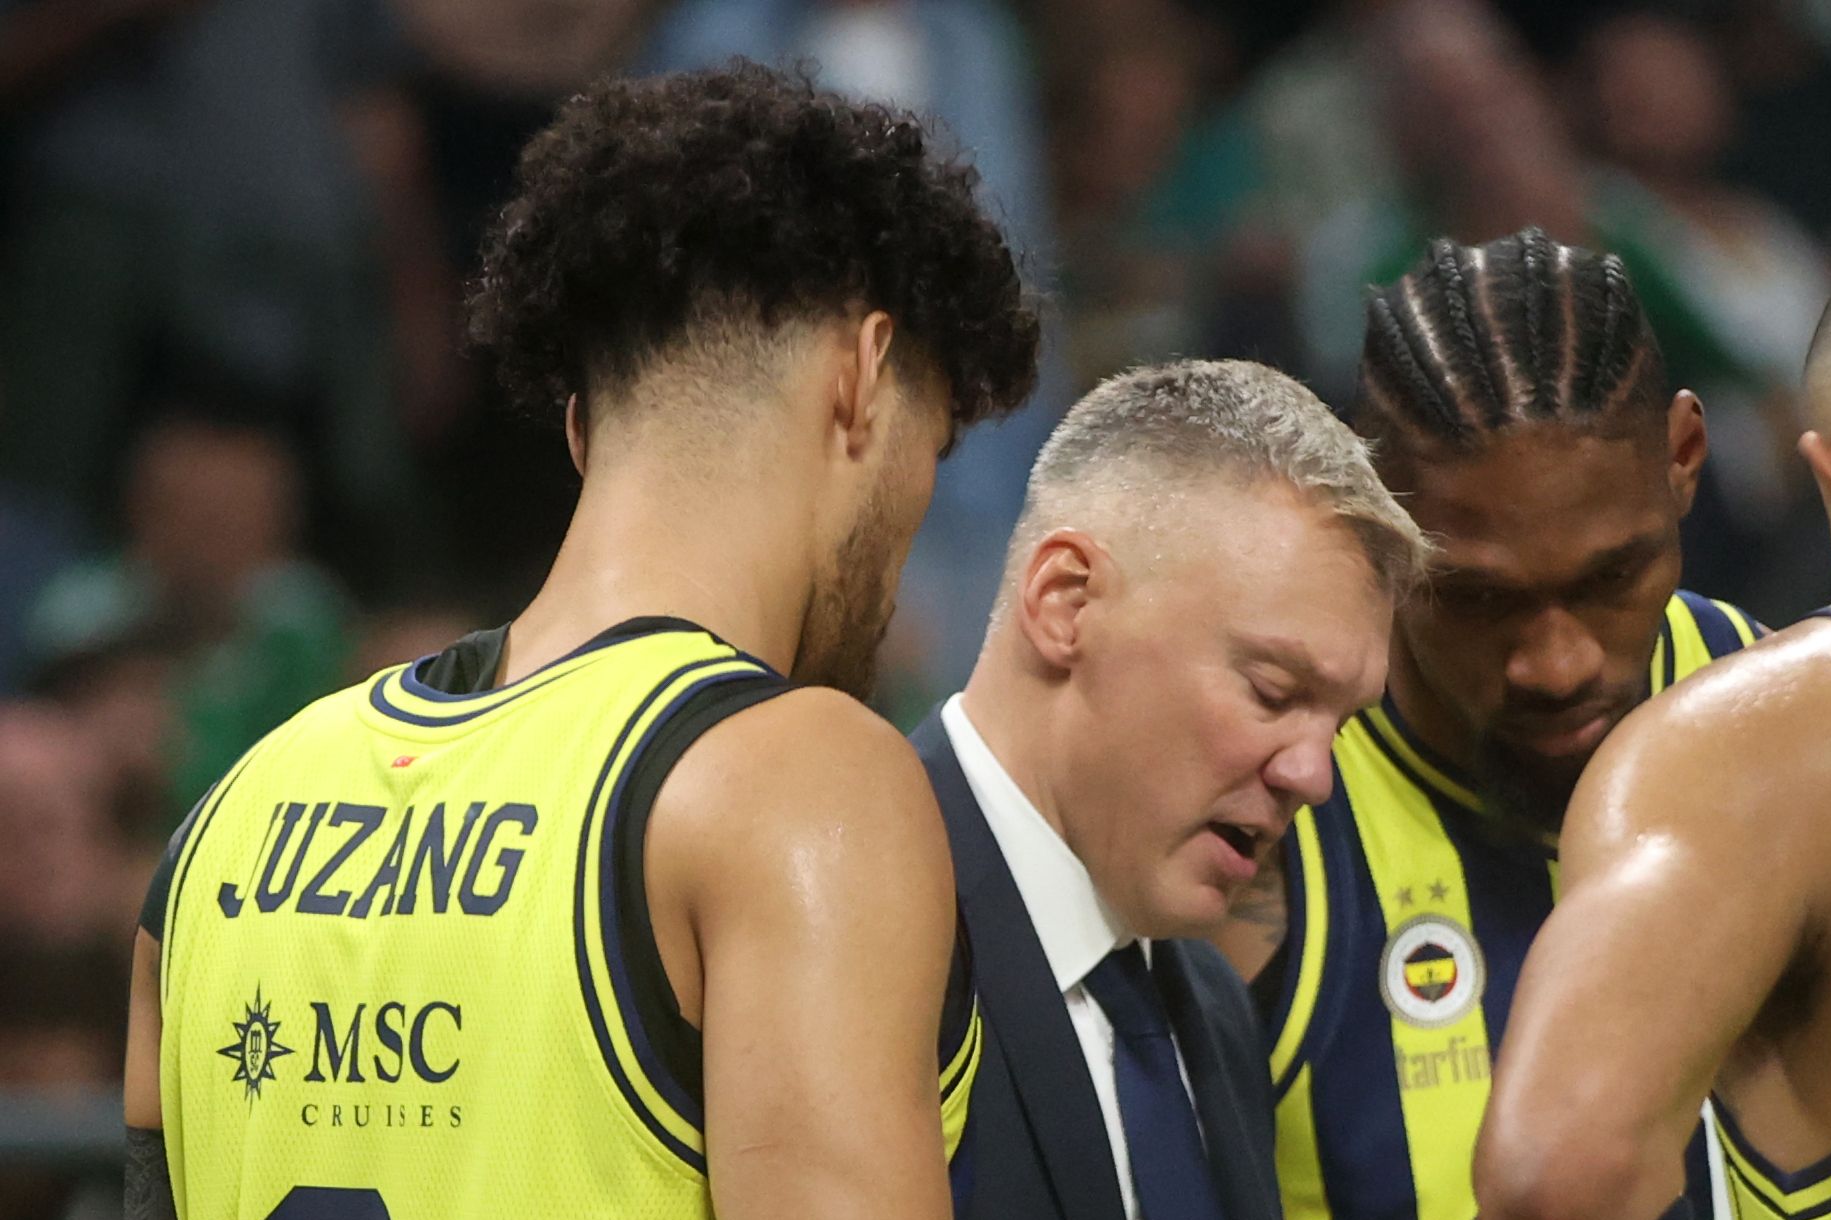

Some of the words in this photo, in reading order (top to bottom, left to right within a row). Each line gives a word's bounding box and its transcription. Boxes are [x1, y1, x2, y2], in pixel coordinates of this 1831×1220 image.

[217, 800, 538, 919] JUZANG
[303, 1001, 462, 1084] MSC
[301, 1103, 462, 1128] CRUISES
